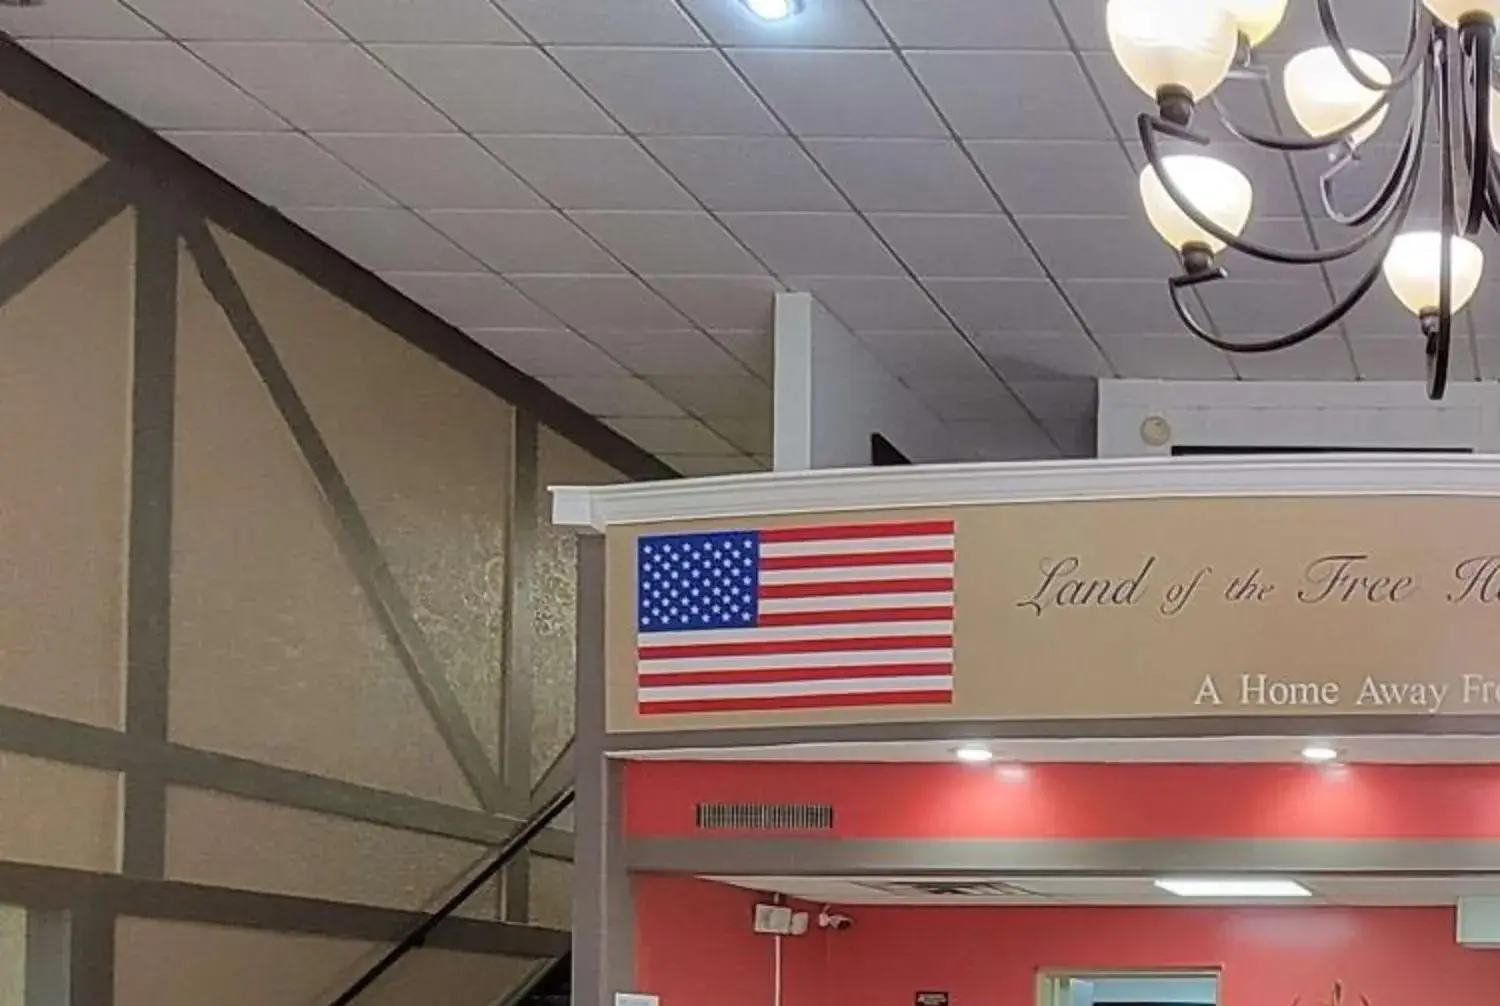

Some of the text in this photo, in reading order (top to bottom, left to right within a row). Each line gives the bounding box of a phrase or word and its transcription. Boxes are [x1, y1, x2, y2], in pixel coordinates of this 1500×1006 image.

[1016, 555, 1156, 616] Land
[1160, 566, 1212, 615] of
[1224, 567, 1275, 602] the
[1297, 554, 1415, 604] Free
[1193, 674, 1223, 705] A
[1240, 674, 1340, 705] Home
[1355, 675, 1448, 713] Away
